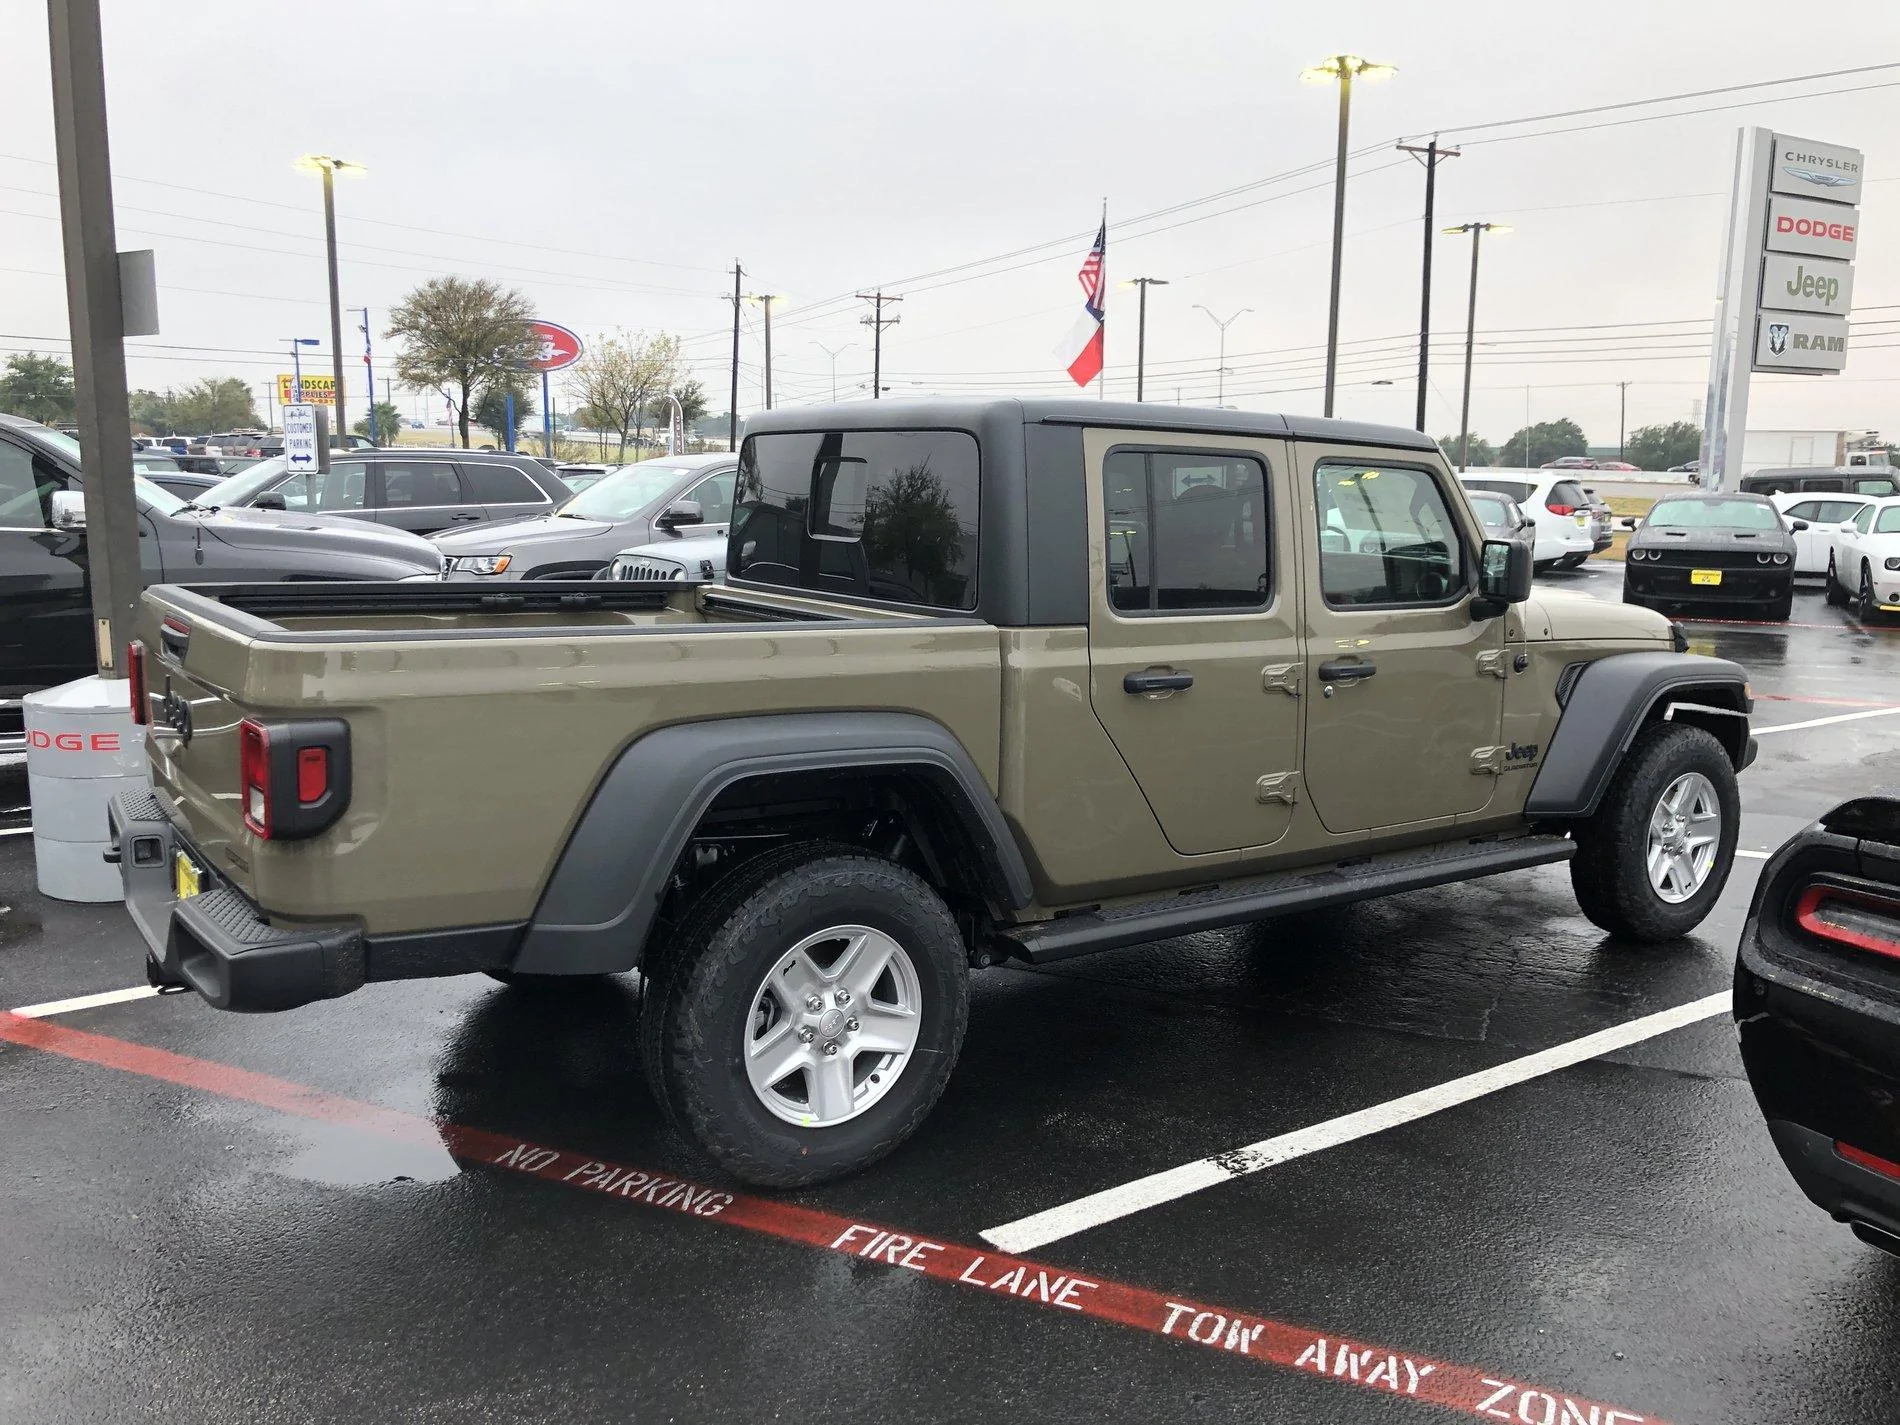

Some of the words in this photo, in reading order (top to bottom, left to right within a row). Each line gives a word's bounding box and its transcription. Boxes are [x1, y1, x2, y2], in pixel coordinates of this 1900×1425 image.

[1785, 151, 1858, 173] CHRYSLER
[1777, 216, 1855, 242] DODGE
[1786, 265, 1839, 307] Jeep
[1793, 333, 1845, 352] RAM
[283, 379, 336, 390] LNDSCAP
[300, 390, 329, 399] PPLIES
[287, 422, 312, 434] CUSTOMER
[289, 438, 312, 450] PARKING
[26, 729, 121, 751] DGE
[1505, 742, 1538, 761] Jeep
[494, 1143, 560, 1172] NO
[562, 1161, 734, 1216] PARKING
[830, 1224, 946, 1271] FIRE
[958, 1256, 1099, 1310] LANE
[1161, 1302, 1265, 1353] TOW
[1294, 1338, 1437, 1394] AWAY
